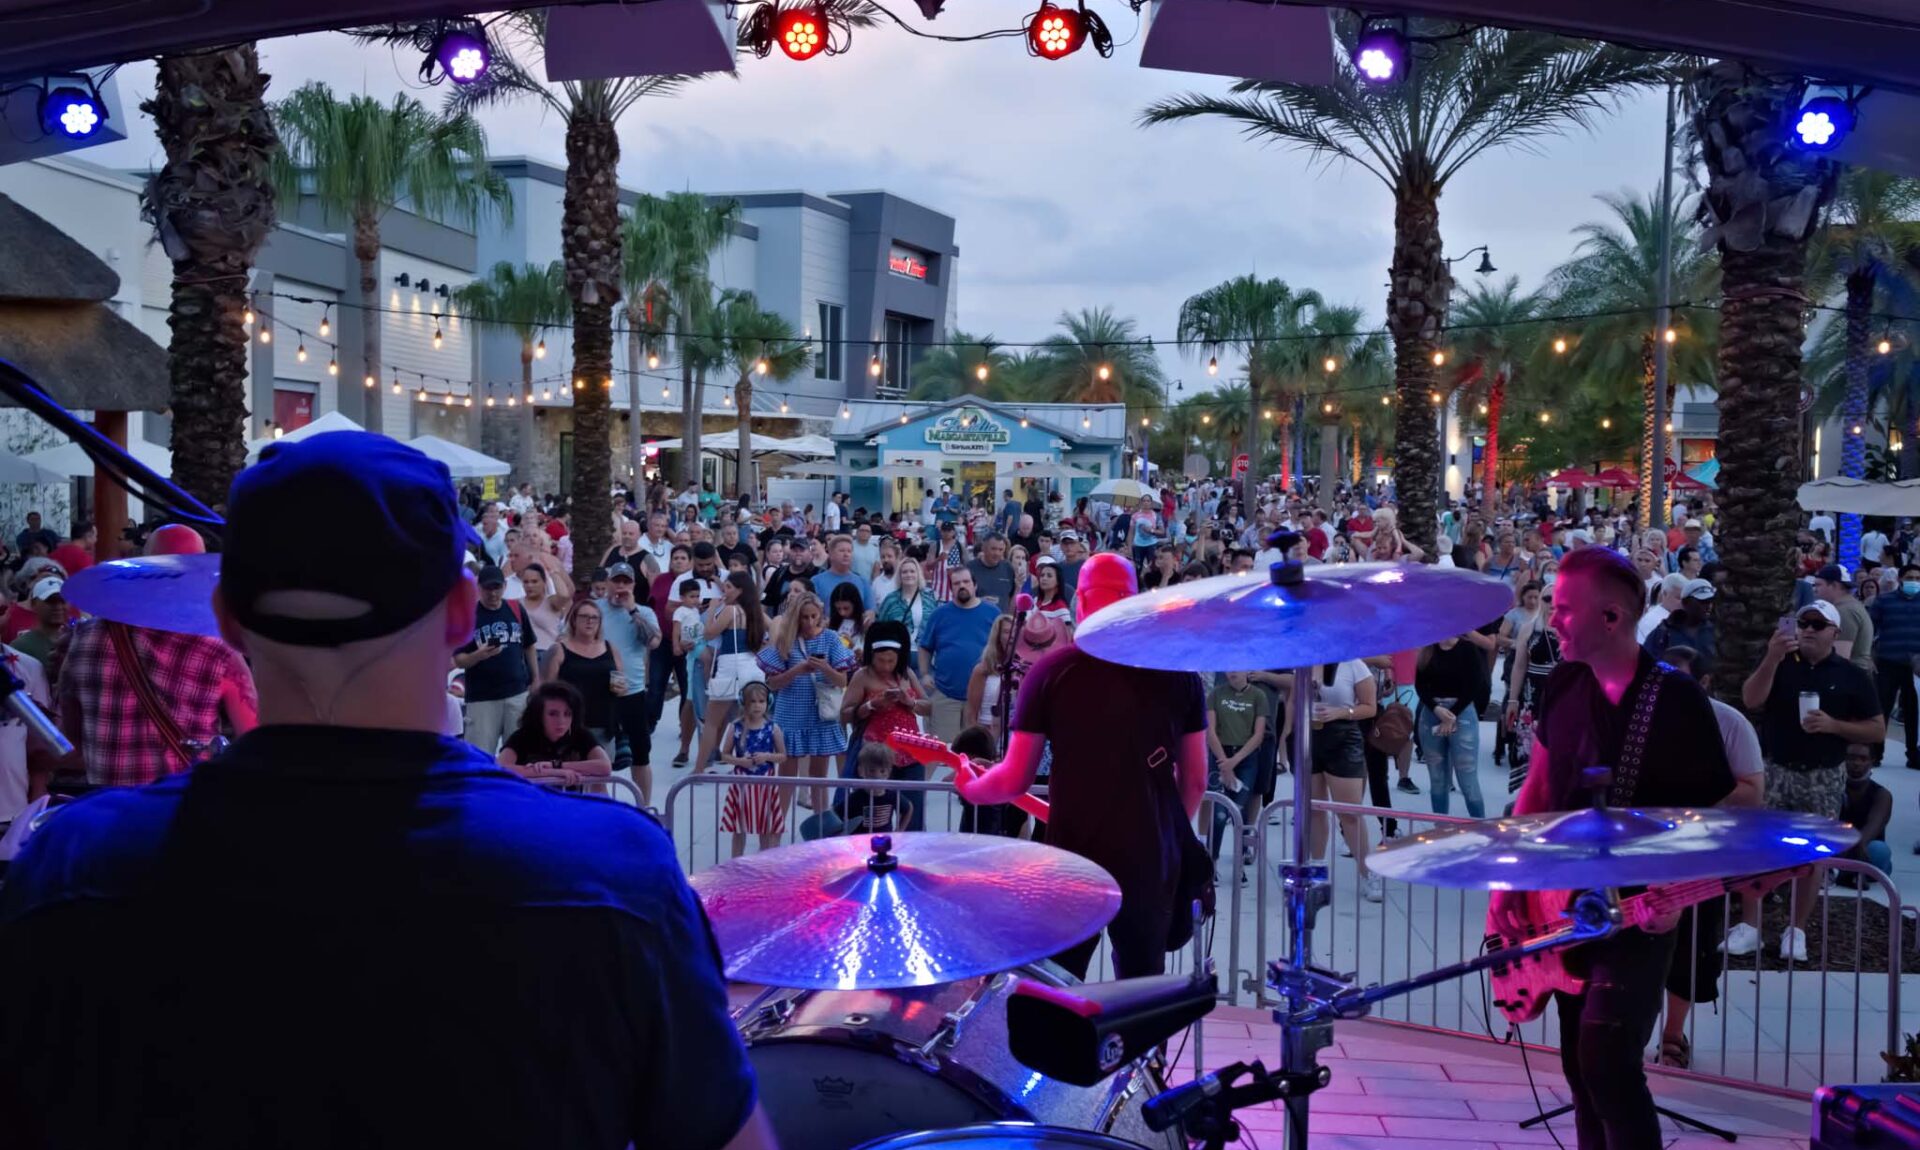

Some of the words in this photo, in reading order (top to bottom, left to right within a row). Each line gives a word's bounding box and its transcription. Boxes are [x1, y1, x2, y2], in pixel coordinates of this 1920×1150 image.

[928, 430, 1007, 442] MARGARITAVILLE
[1236, 459, 1249, 469] STO
[474, 621, 522, 646] USA
